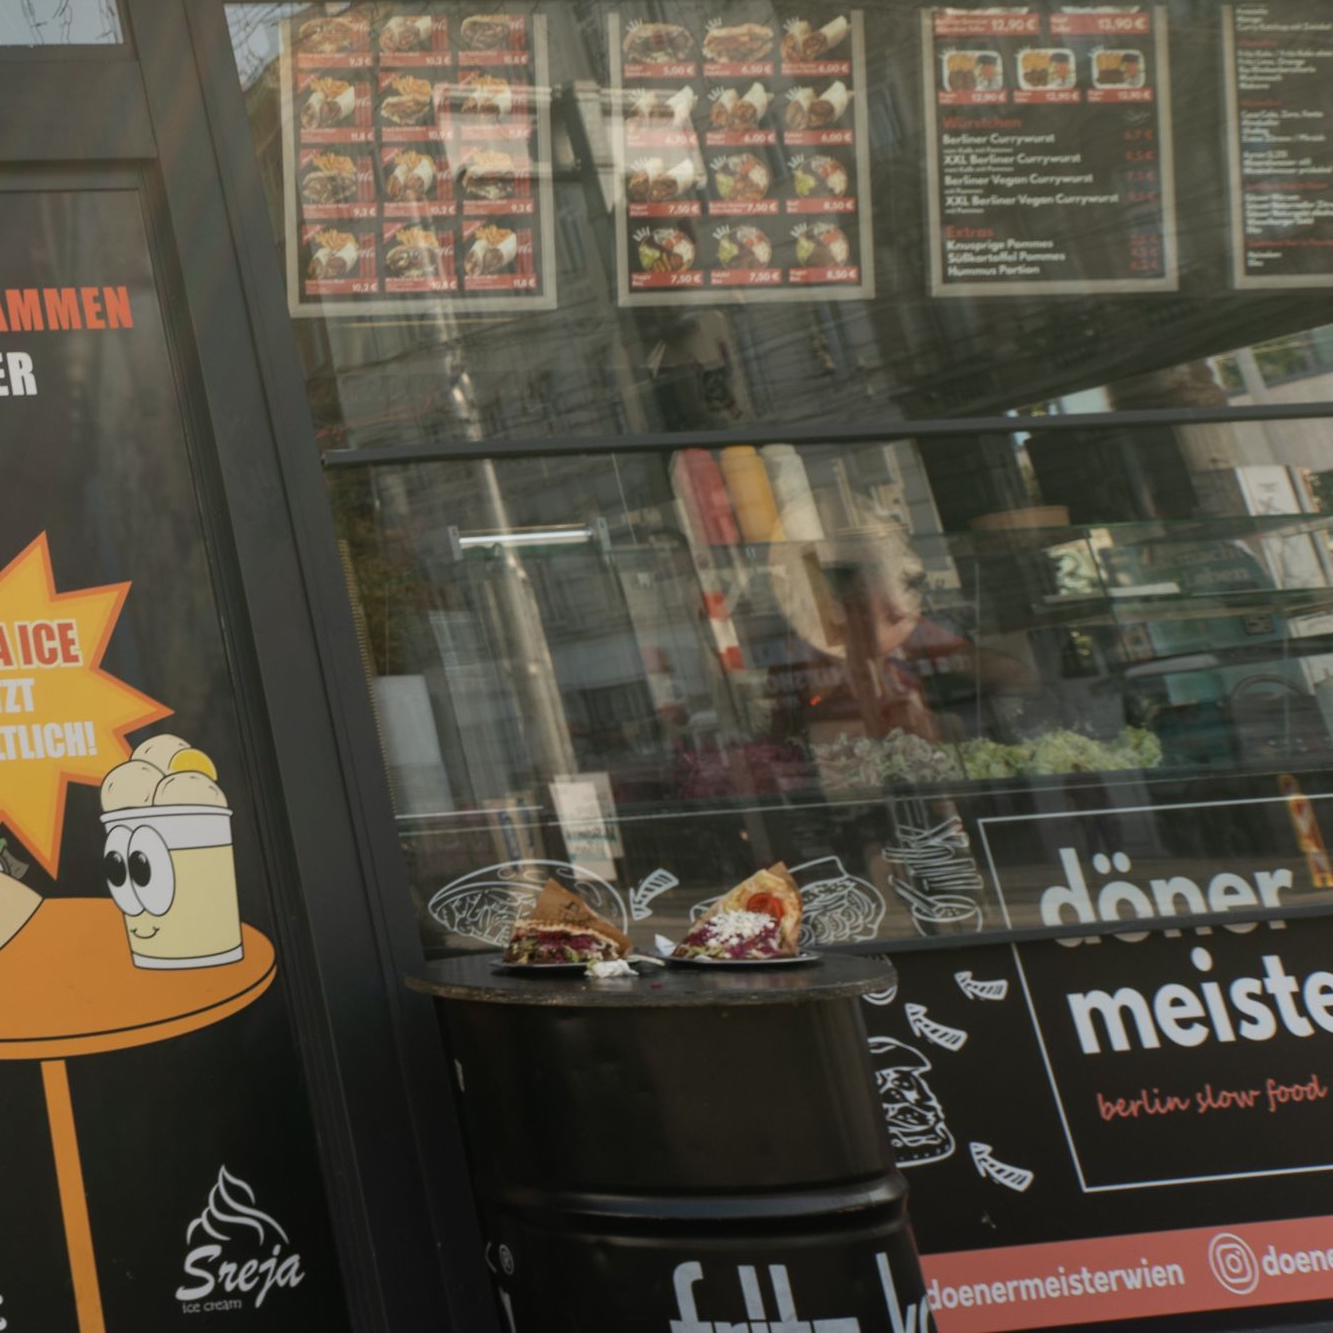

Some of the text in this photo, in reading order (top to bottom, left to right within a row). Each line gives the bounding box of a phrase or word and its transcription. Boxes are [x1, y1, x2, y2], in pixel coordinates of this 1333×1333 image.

[1025, 18, 1037, 29] €
[1133, 17, 1146, 29] €
[943, 133, 1055, 146] Berliner Currywurst
[943, 153, 1081, 166] XXL Berliner Currywurst
[945, 173, 1094, 187] Berliner Vegan Currywurst
[945, 193, 1120, 208] XXL Berliner Vegan Currywurst
[947, 239, 1054, 252] Knusprige Pommes
[1019, 251, 1066, 262] Pommes
[948, 264, 1040, 277] Hummus Portion
[17, 622, 80, 667] ICE
[1040, 848, 1293, 948] döner
[1097, 1073, 1328, 1122] berlin slow food
[175, 1244, 306, 1308] Sreja
[182, 1299, 243, 1314] ice cream
